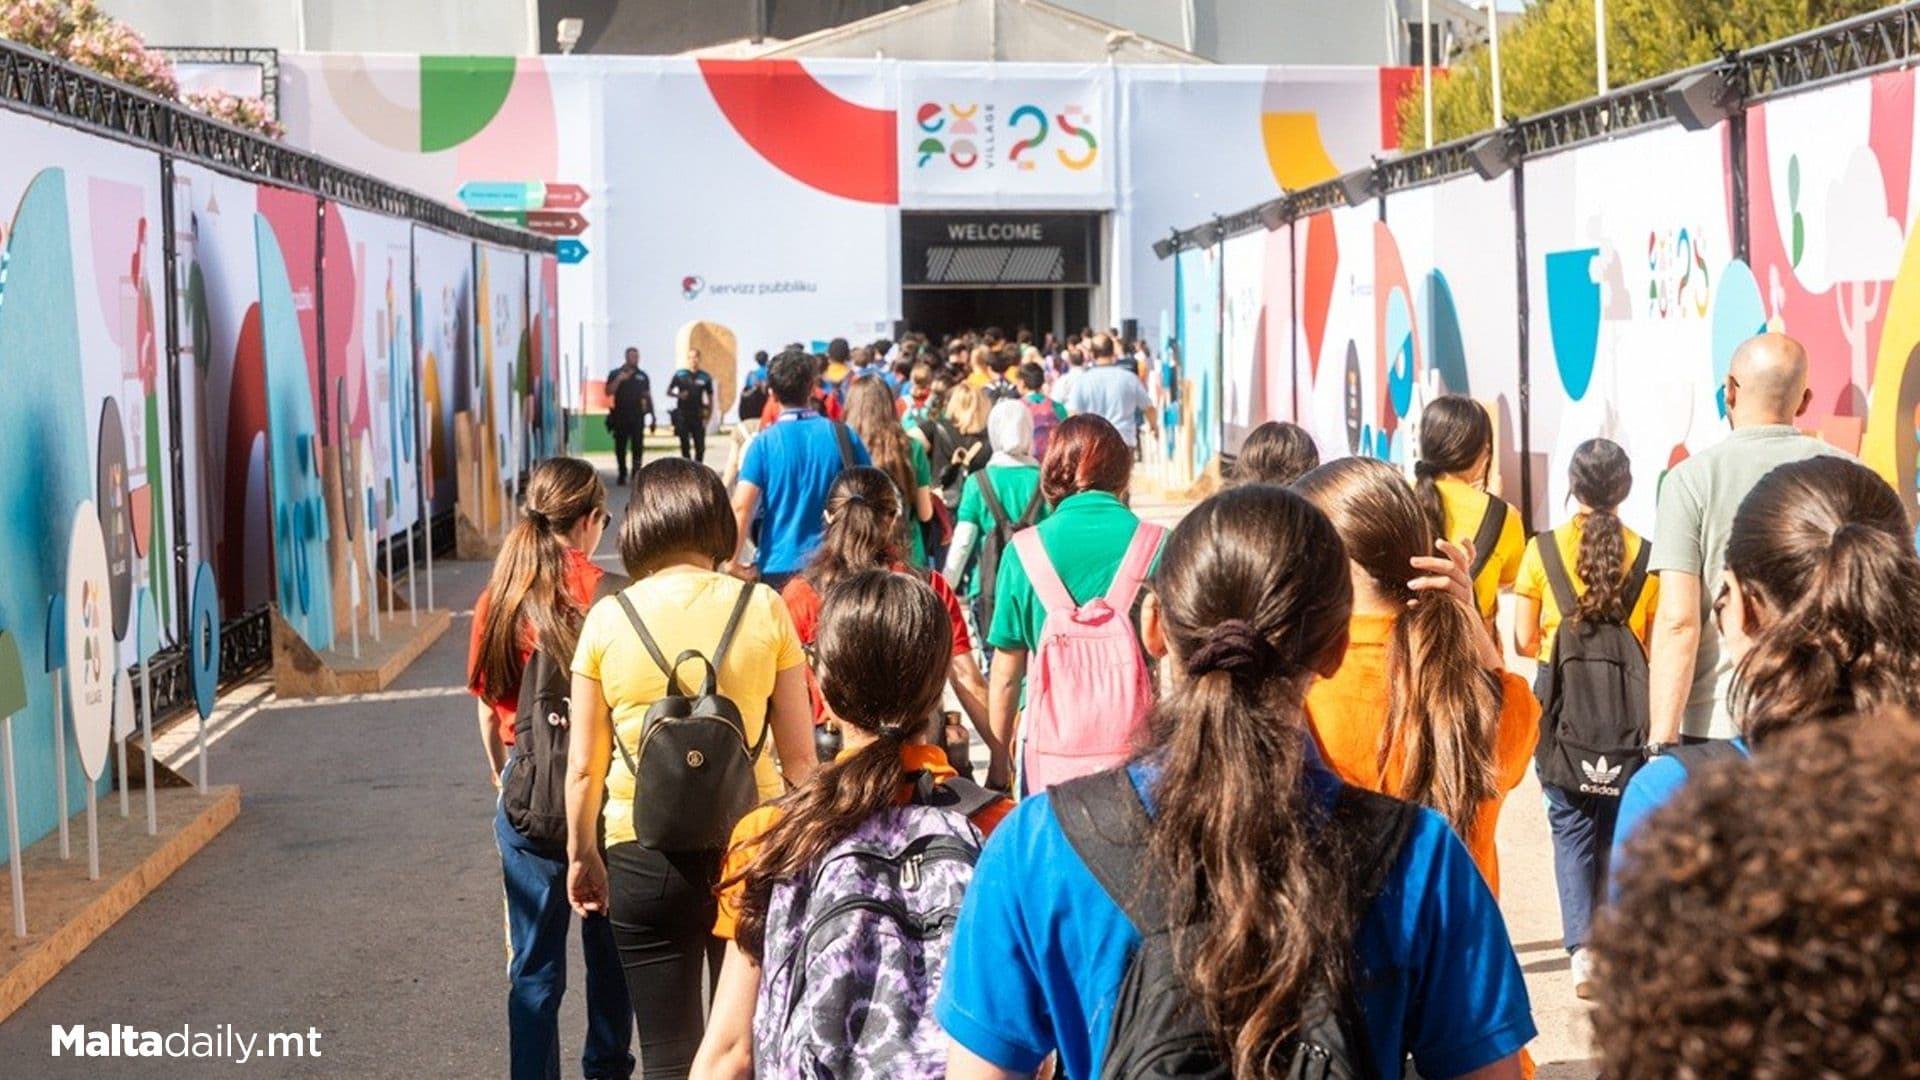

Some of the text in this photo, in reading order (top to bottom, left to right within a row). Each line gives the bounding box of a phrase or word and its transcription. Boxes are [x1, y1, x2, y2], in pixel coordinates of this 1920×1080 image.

[984, 104, 995, 169] VILLAGE
[947, 223, 1043, 240] WELCOME
[710, 280, 817, 296] servizz pubbliku
[1580, 783, 1620, 796] adidas
